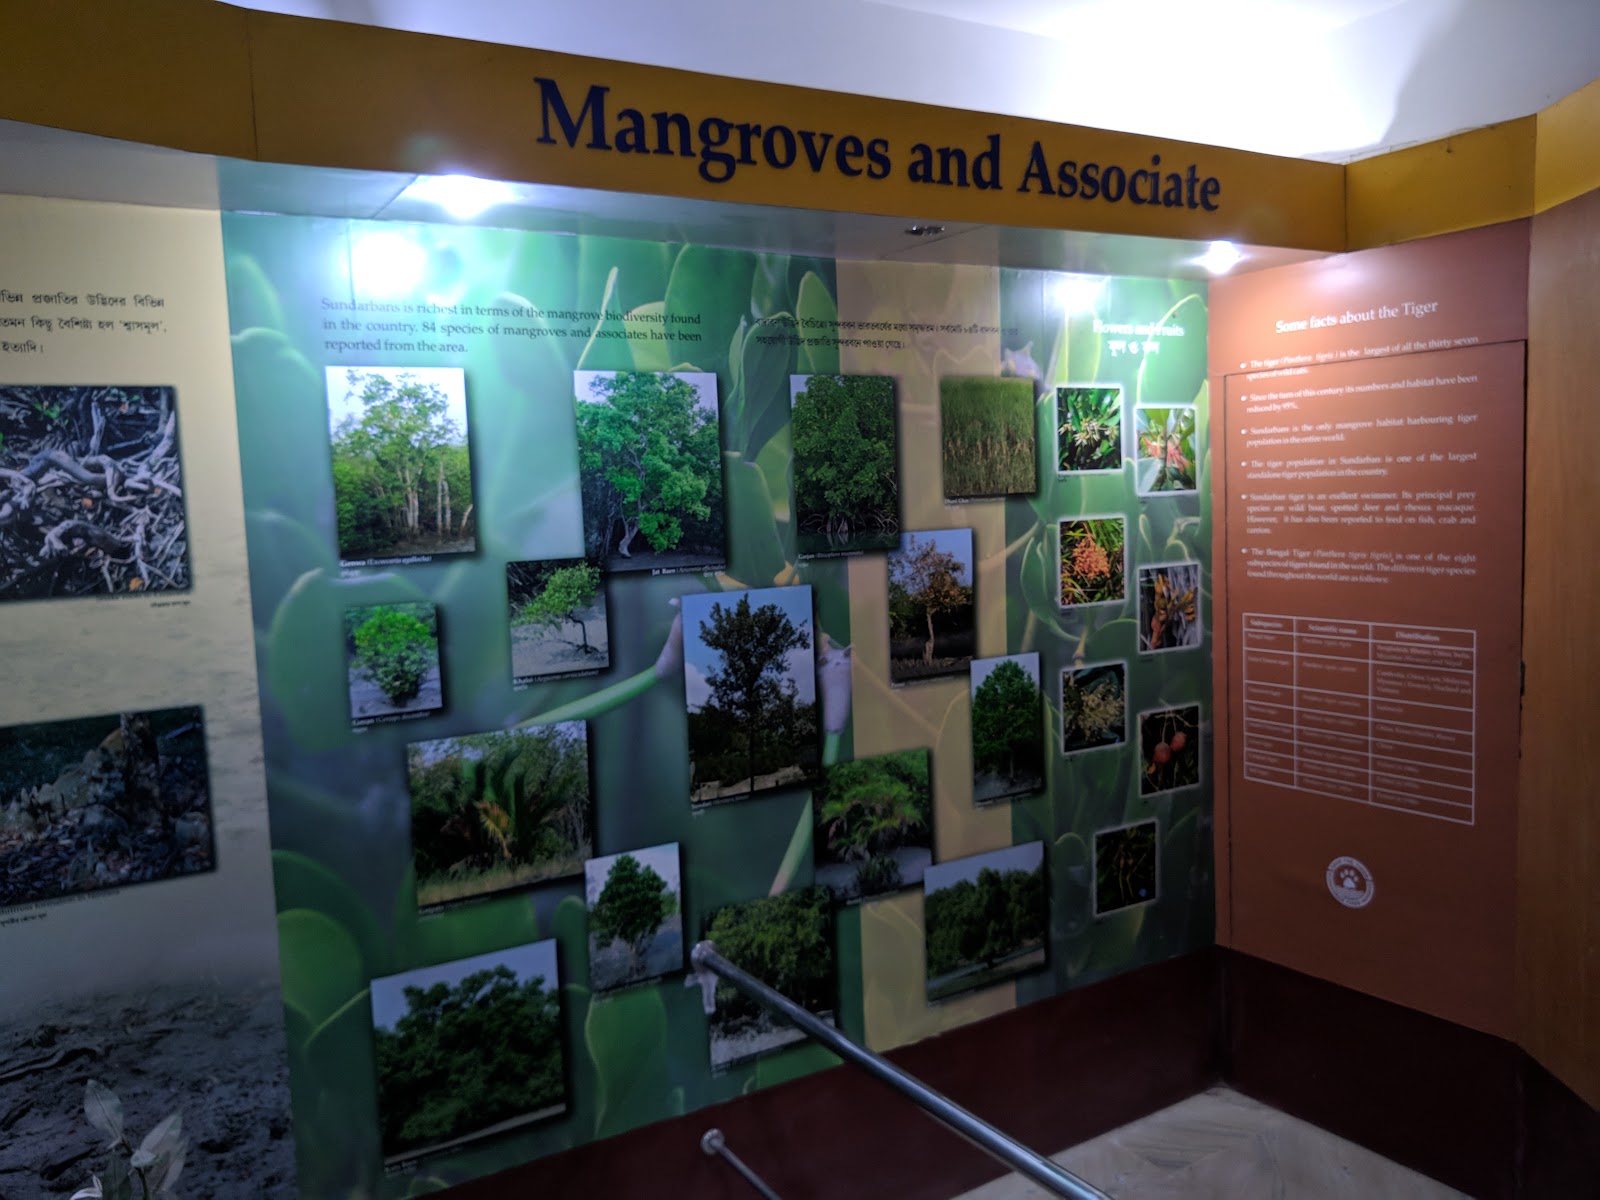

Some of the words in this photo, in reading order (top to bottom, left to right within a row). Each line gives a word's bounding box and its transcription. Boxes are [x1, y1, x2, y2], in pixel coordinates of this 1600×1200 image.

[532, 76, 892, 183] Mangroves
[907, 134, 1002, 190] and
[1017, 140, 1221, 212] Associate
[322, 298, 400, 312] Sundarbans
[404, 303, 414, 313] is
[416, 302, 457, 315] richest
[460, 306, 472, 316] in
[476, 306, 509, 317] terms
[512, 307, 524, 318] of
[526, 308, 544, 318] the
[547, 310, 604, 324] mangrove
[606, 310, 668, 326] biodiversity
[670, 312, 700, 325] found
[1276, 319, 1308, 334] Some
[1310, 316, 1337, 329] facts
[1340, 311, 1375, 324] about
[1378, 306, 1398, 319] the
[1402, 300, 1438, 318] Tiger
[324, 318, 337, 330] in
[341, 318, 361, 331] the
[366, 322, 418, 336] country.
[422, 322, 436, 332] 84
[440, 324, 484, 337] species
[487, 324, 500, 335] of
[503, 326, 568, 340] mangroves
[570, 328, 591, 338] and
[595, 328, 648, 340] associates
[650, 330, 676, 341] have
[678, 330, 702, 342] been
[324, 338, 381, 353] reported
[384, 340, 415, 352] from
[417, 341, 436, 352] the
[439, 344, 468, 353] area.
